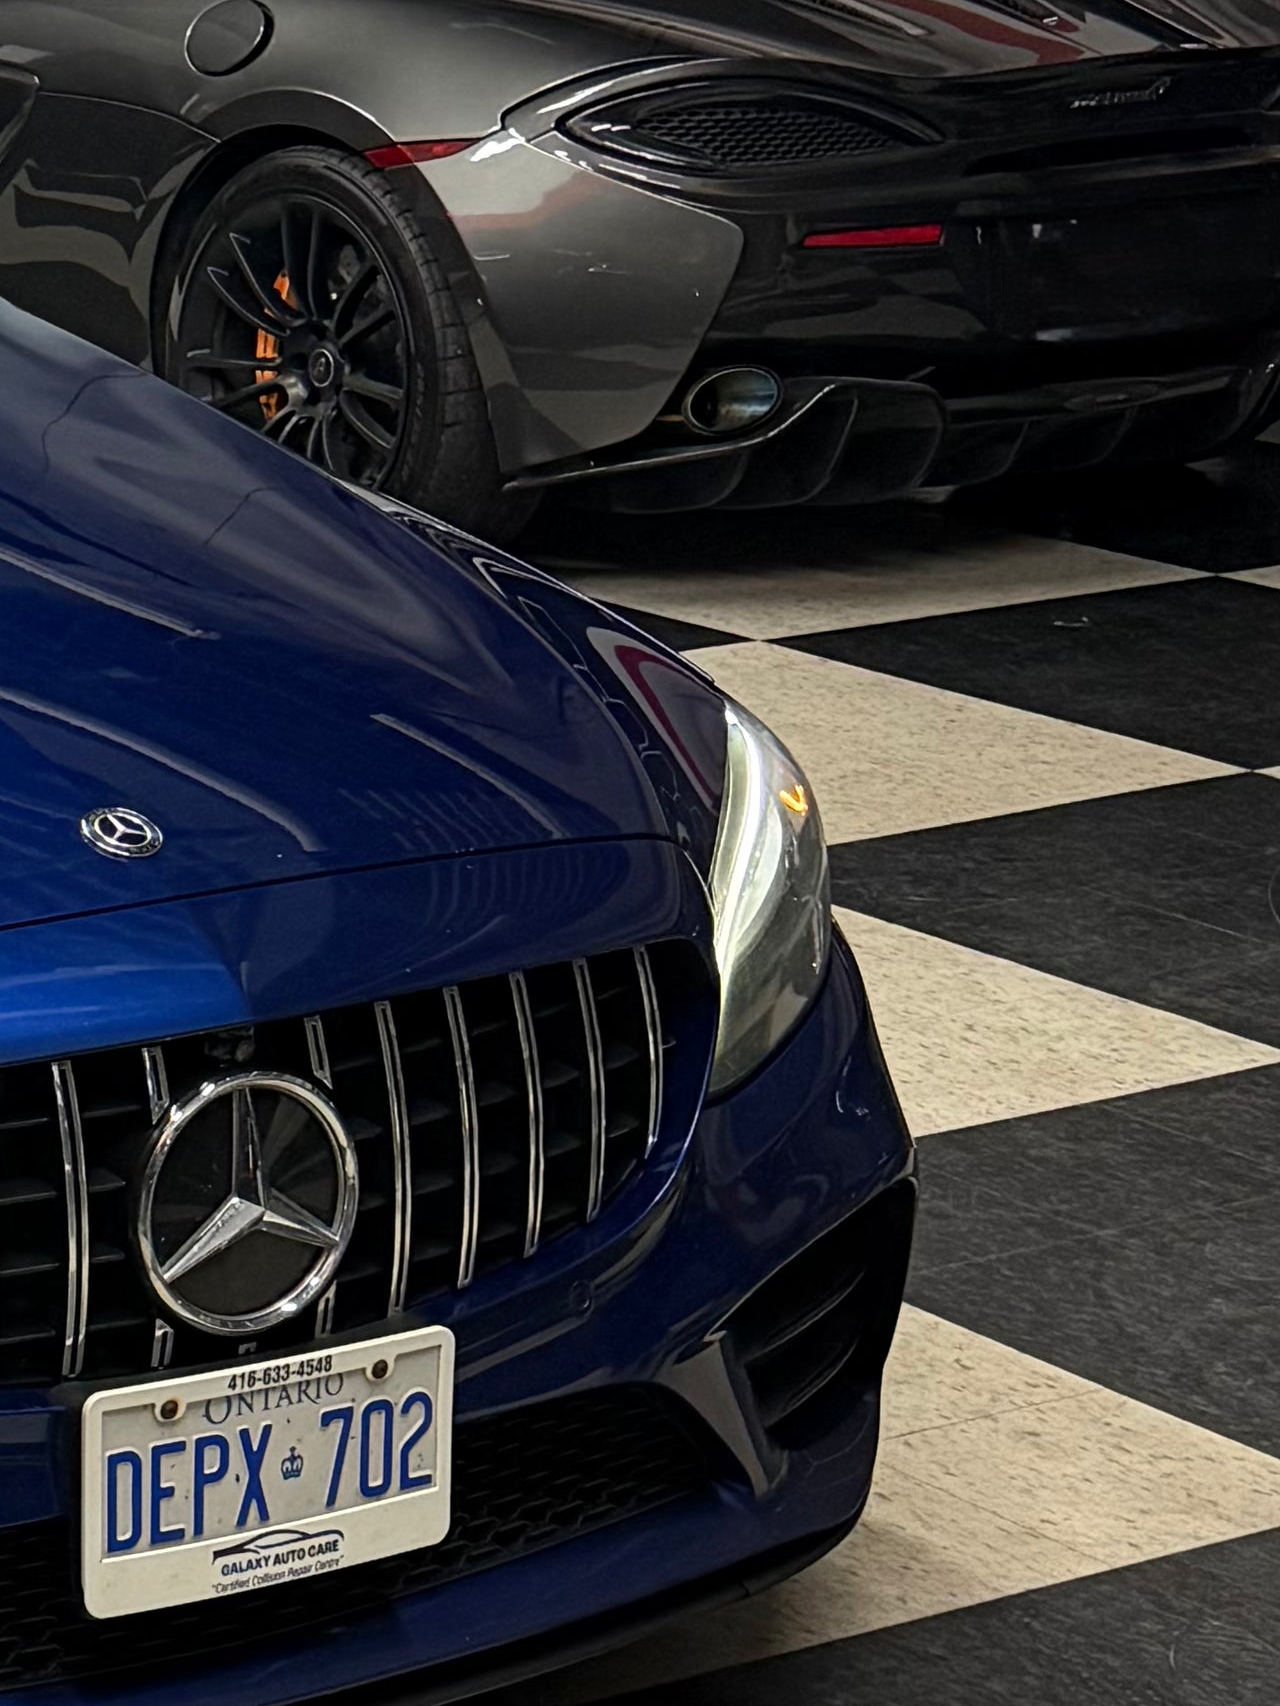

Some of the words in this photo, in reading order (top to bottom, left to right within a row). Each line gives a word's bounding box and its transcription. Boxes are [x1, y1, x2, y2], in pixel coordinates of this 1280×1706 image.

[227, 1354, 333, 1391] 416-633-4548
[201, 1372, 344, 1425] ONTARIO
[106, 1423, 273, 1553] DEPX
[319, 1391, 433, 1508] 702
[221, 1554, 271, 1576] GALAXY
[273, 1548, 306, 1566] AUTO
[307, 1539, 340, 1558] CARE
